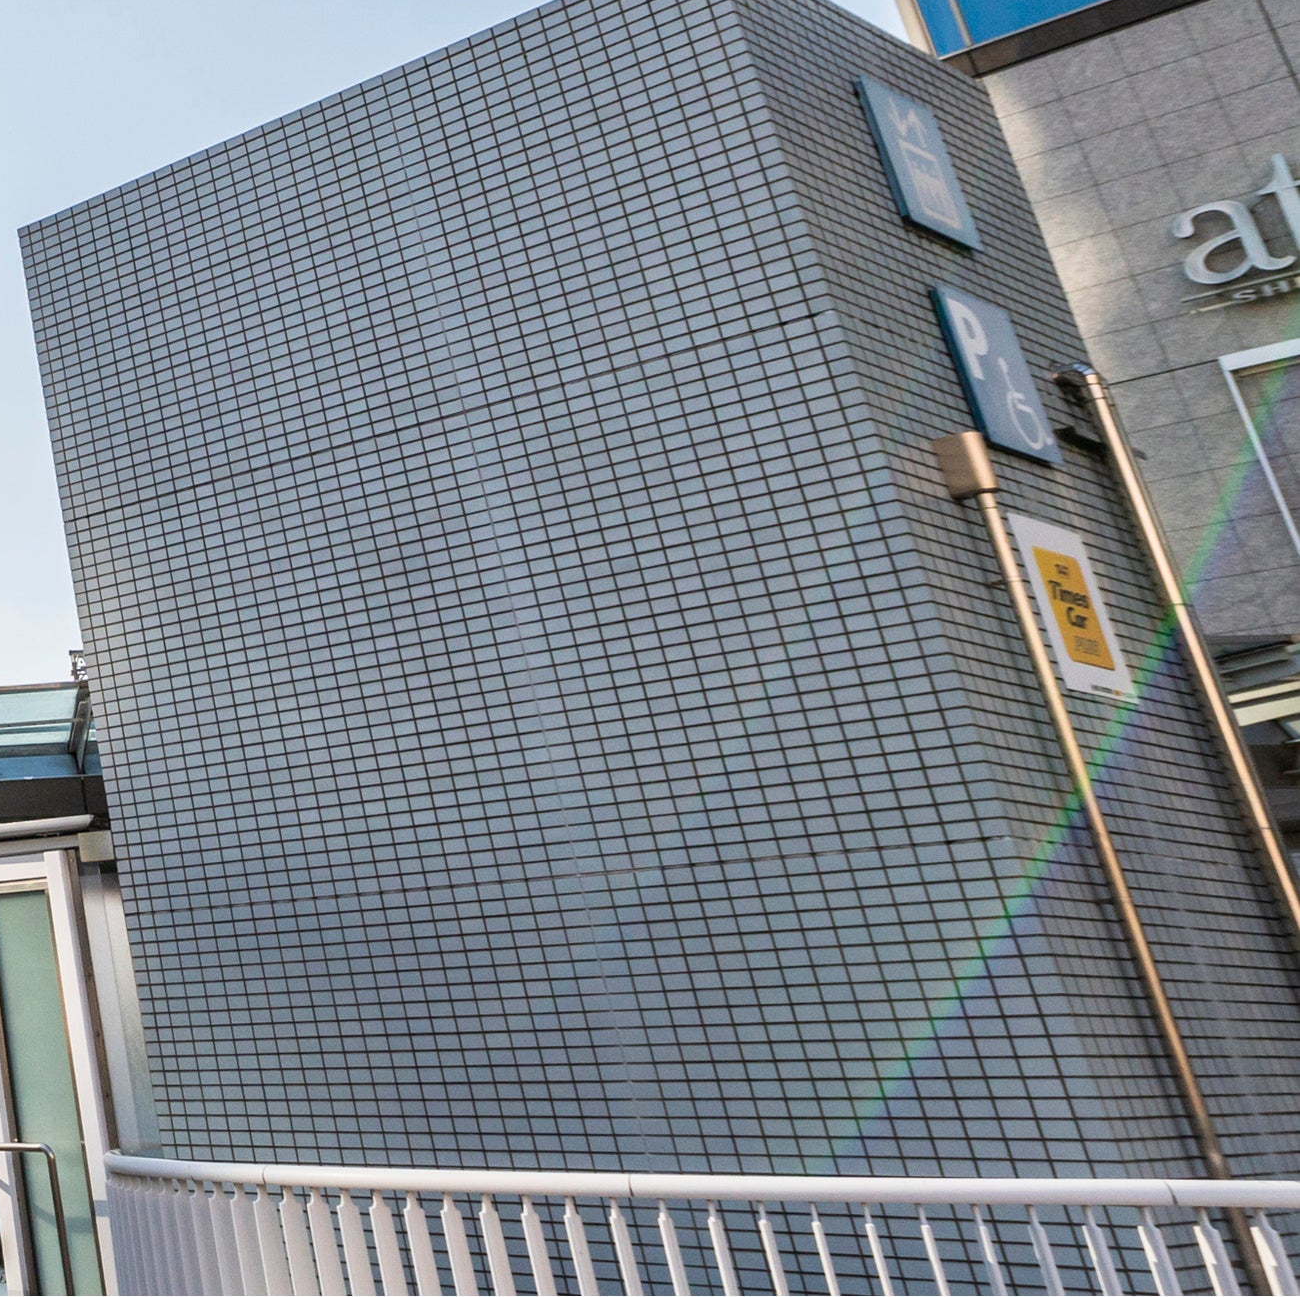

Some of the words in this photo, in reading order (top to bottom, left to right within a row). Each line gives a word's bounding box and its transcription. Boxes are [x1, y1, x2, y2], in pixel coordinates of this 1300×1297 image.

[947, 297, 989, 381] P
[1047, 579, 1090, 609] Times
[1065, 606, 1088, 629] Car
